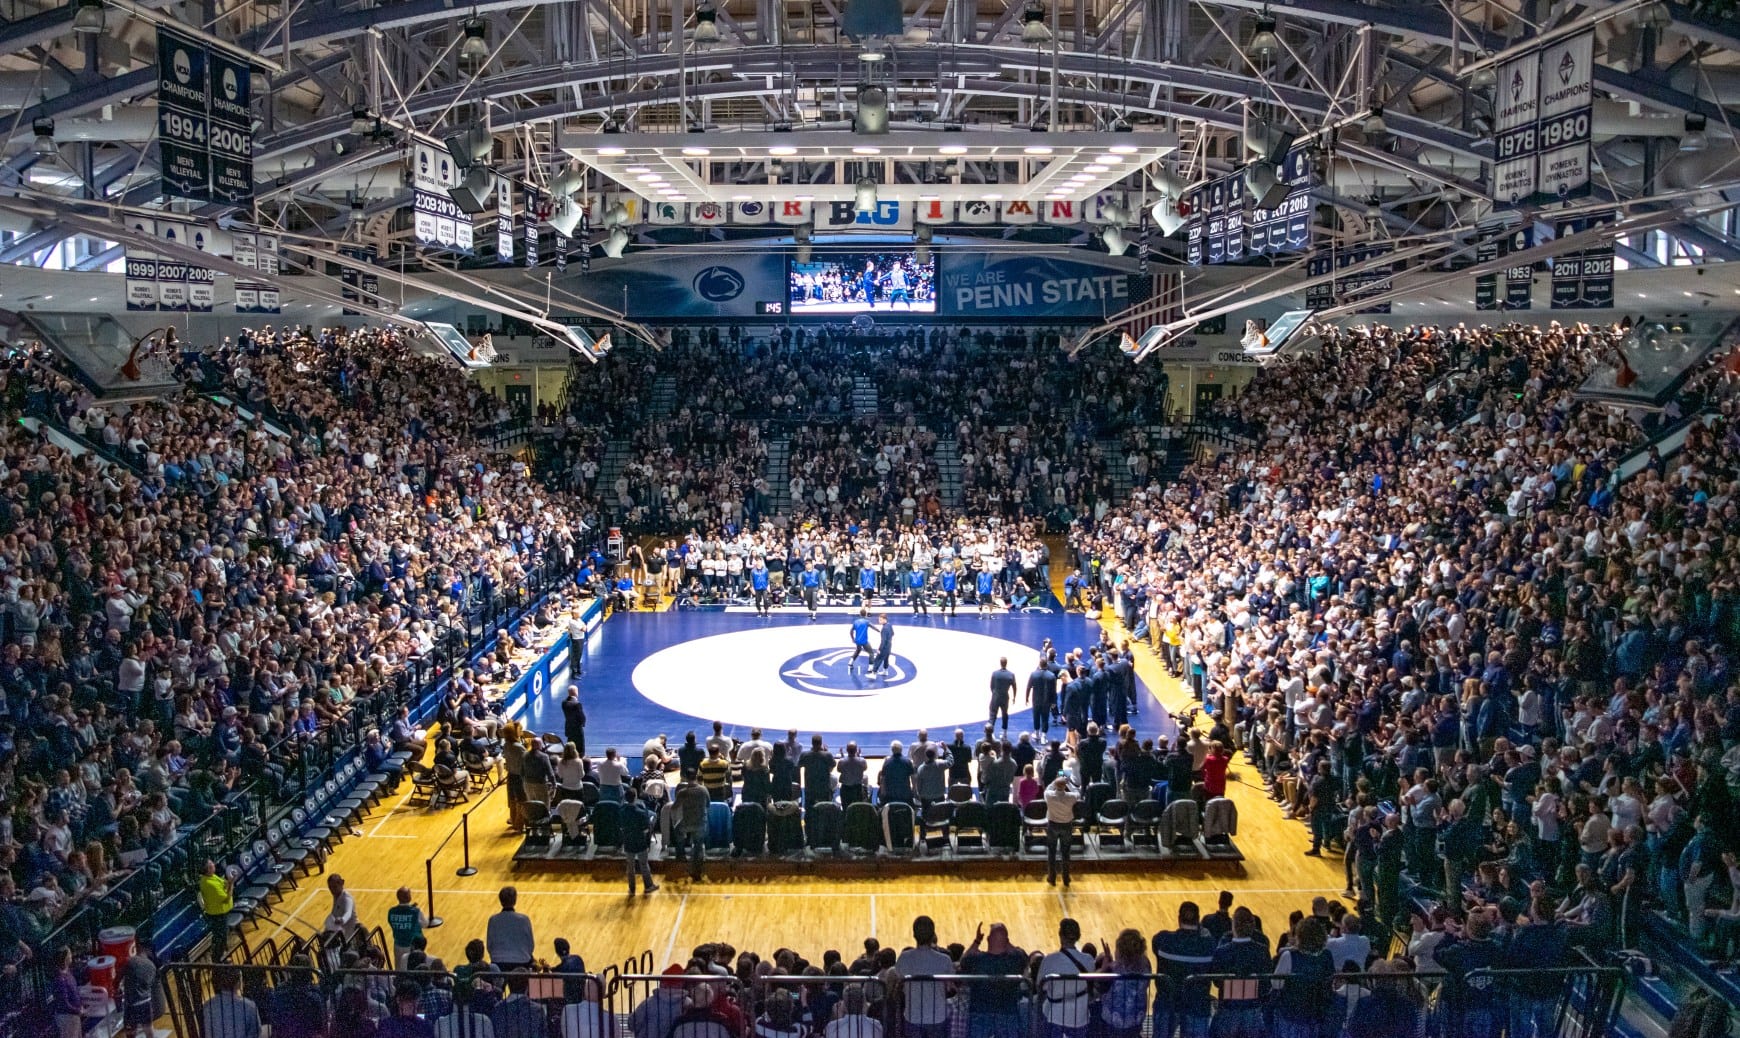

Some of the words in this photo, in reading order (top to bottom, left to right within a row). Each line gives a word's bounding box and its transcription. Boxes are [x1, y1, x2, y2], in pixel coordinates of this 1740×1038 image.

[1544, 82, 1590, 106] CHAMPIONS
[162, 112, 207, 144] 1994
[1541, 114, 1588, 147] 1980
[1500, 128, 1536, 158] 1978
[1052, 201, 1073, 218] N
[127, 262, 156, 277] 1999
[158, 265, 186, 279] 2007
[188, 266, 215, 281] 2008
[1508, 266, 1531, 279] 1953
[1554, 262, 1580, 277] 2011
[1584, 260, 1612, 275] 2012
[945, 273, 969, 287] WE
[975, 271, 1007, 284] ARE
[956, 282, 1034, 311] PENN
[1041, 274, 1129, 304] STATE
[390, 914, 413, 922] EVENT
